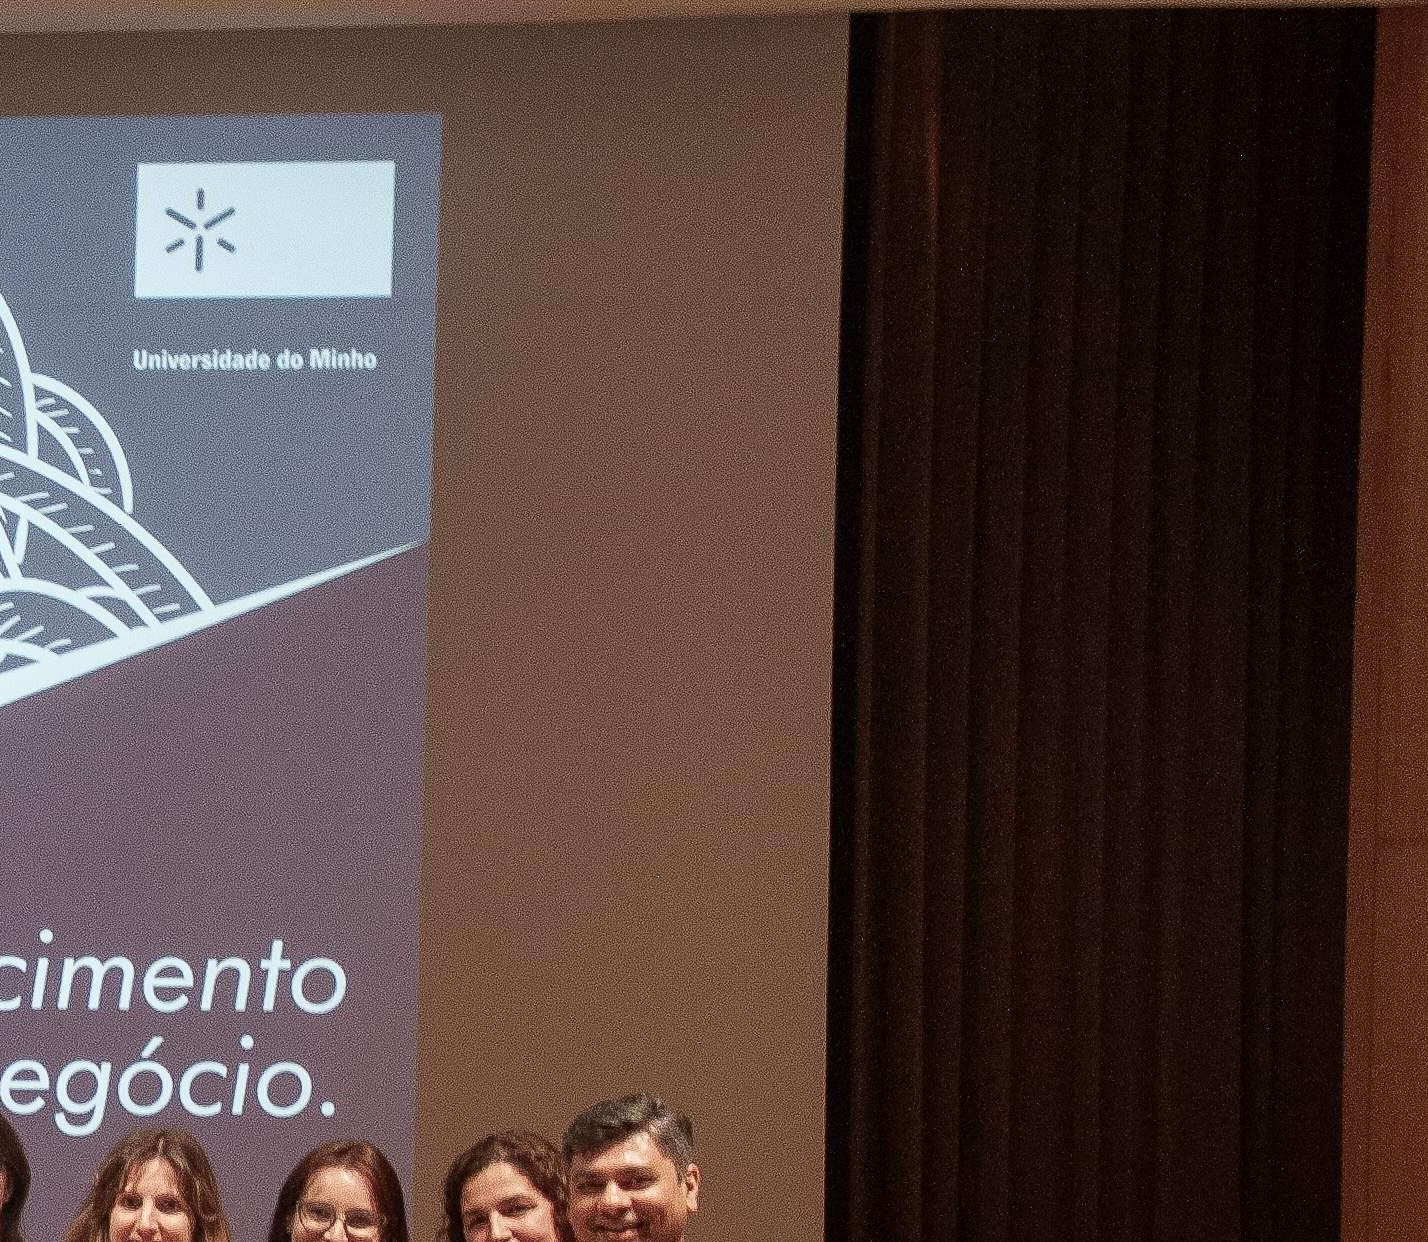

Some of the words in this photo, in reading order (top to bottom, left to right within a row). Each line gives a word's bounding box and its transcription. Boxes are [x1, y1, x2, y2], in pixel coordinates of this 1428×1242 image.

[133, 349, 270, 371] Universidade
[277, 349, 304, 371] do
[310, 348, 377, 371] Minho
